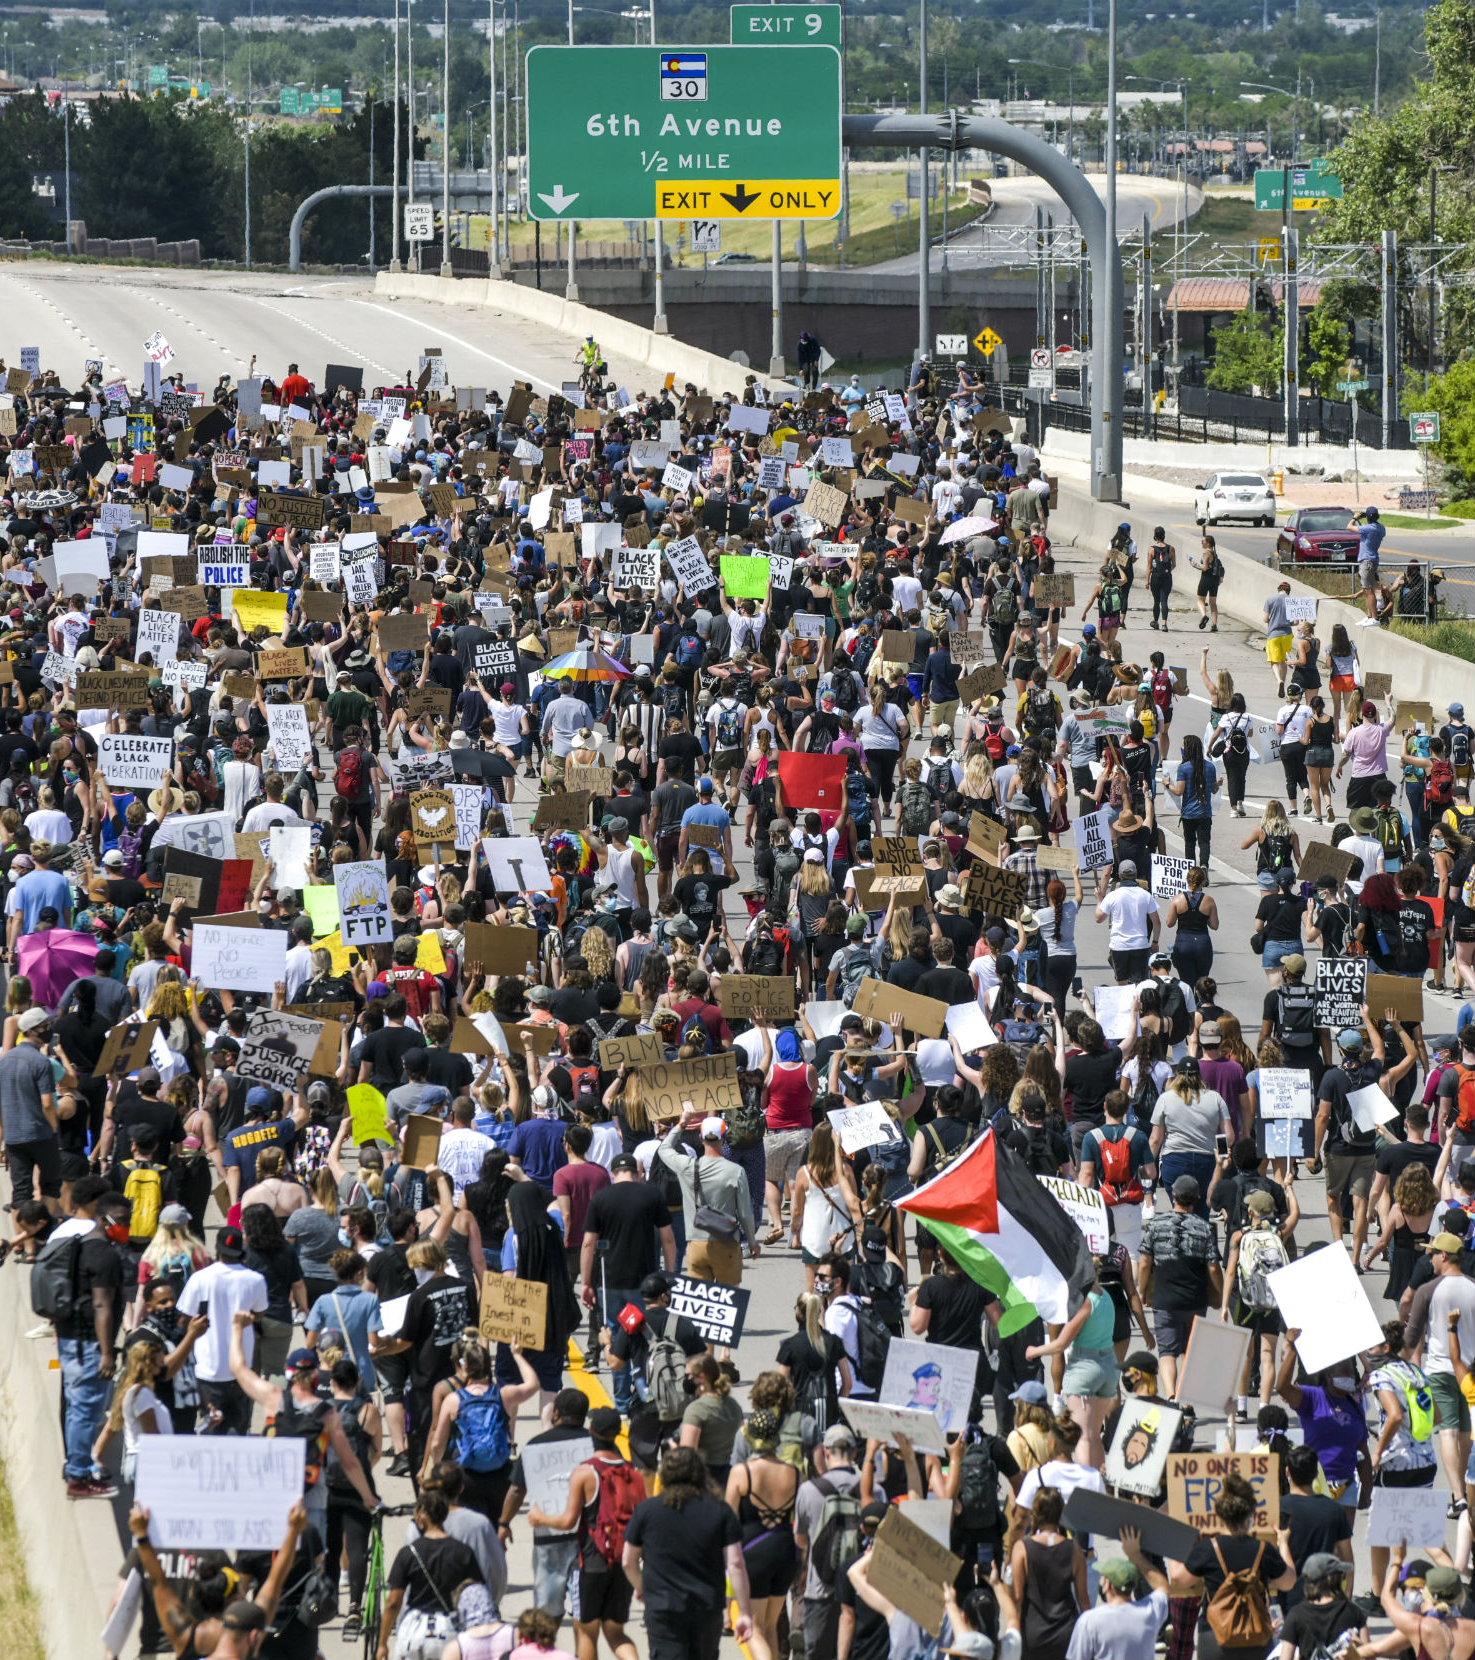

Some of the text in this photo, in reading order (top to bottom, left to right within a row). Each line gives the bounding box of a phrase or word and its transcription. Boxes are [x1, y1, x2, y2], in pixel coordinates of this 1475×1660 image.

[749, 14, 823, 35] EXIT 9
[670, 81, 699, 98] 30
[586, 113, 782, 137] 6th Avenue
[678, 154, 730, 169] MILE
[662, 191, 833, 209] EXIT ONLY
[407, 207, 430, 215] SPEED
[409, 216, 428, 224] LIMIT
[409, 224, 430, 236] 65
[384, 398, 406, 407] JUSTICE
[388, 406, 399, 414] FOR
[215, 455, 245, 467] NO PEACE
[258, 496, 320, 516] NO JUSTICE
[267, 511, 320, 527] NO PEACE
[200, 545, 250, 566] ABOLISH THE
[618, 551, 656, 566] BLACK
[351, 564, 366, 575] JAIL
[621, 564, 655, 577] LIVES
[677, 559, 704, 576] BLACK
[204, 565, 243, 585] POLICE
[354, 574, 367, 584] ALL
[618, 576, 656, 587] MATTER
[684, 569, 705, 581] LIVES
[351, 583, 373, 593] KILLER
[142, 610, 177, 624] BLACK
[1290, 606, 1314, 618] MATTER
[147, 623, 175, 633] LIVES
[950, 631, 968, 639] HOW
[137, 631, 175, 644] MATTER
[951, 638, 972, 646] MANY
[476, 640, 510, 654] BLACK
[46, 652, 64, 665] END
[261, 651, 290, 662] BLACK
[274, 658, 298, 667] LIVES
[478, 653, 510, 666] LIVES
[952, 652, 984, 662] FILMED
[165, 659, 208, 673] NO JUSTICE
[267, 666, 299, 678] MATTER
[477, 663, 518, 677] MATTER
[78, 674, 150, 689] BLACK LIVES MATTER
[164, 671, 205, 684] NO PEACE
[965, 673, 996, 689] SAY HIS
[79, 690, 113, 704] DEFUND
[273, 709, 284, 721] WE
[281, 729, 290, 737] TO
[291, 722, 303, 732] YOU
[102, 738, 171, 755] CELEBRATE
[278, 747, 302, 759] SERVE
[115, 752, 150, 764] BLACK
[100, 763, 164, 781] LIBERATION
[412, 790, 455, 806] PEACE THRU
[1082, 816, 1100, 831] JAIL
[414, 823, 457, 843] ABOLITION
[1086, 829, 1102, 843] ALL
[886, 837, 907, 850] NO
[1081, 838, 1108, 855] KILLER
[876, 848, 922, 865] JUSTICE
[1085, 851, 1108, 864] COPS!
[1153, 855, 1195, 870] JUSTICE
[891, 863, 912, 877] NO
[974, 862, 1026, 890] BLACK
[1163, 866, 1183, 878] FOR
[879, 876, 921, 892] PEACE
[1161, 877, 1187, 888] ELIJAH
[969, 879, 1024, 904] LIVES
[346, 916, 387, 938] FTP
[203, 929, 223, 944] NO
[218, 949, 238, 963] NO
[1316, 962, 1364, 979] BLACK
[739, 977, 770, 990] END
[1317, 977, 1362, 993] LIVES
[731, 991, 787, 1004] POLICE
[1325, 993, 1353, 1002] MATTER
[1334, 1001, 1360, 1009] WORTHY
[1316, 1009, 1361, 1017] ARE BEAUTIFU
[1321, 1017, 1361, 1026] ARE LOVED
[604, 1035, 662, 1066] BLM
[242, 1042, 312, 1076] JUSTICE
[639, 1052, 735, 1088] NO JUSTICE
[643, 1086, 736, 1116] NO PEACE
[231, 1127, 279, 1149] NUGGETS
[486, 1275, 542, 1296] Defund the
[674, 1276, 735, 1305] BLACK
[503, 1293, 527, 1307] Police
[669, 1293, 728, 1321] LIVES
[484, 1304, 532, 1325] Invest in
[533, 1446, 593, 1476] JUSTICE
[1173, 1455, 1269, 1478] NO ONE IS
[1184, 1477, 1266, 1514] FRE
[1411, 1494, 1439, 1508] CALL
[1392, 1510, 1414, 1523] THE
[1385, 1527, 1416, 1545] COPS
